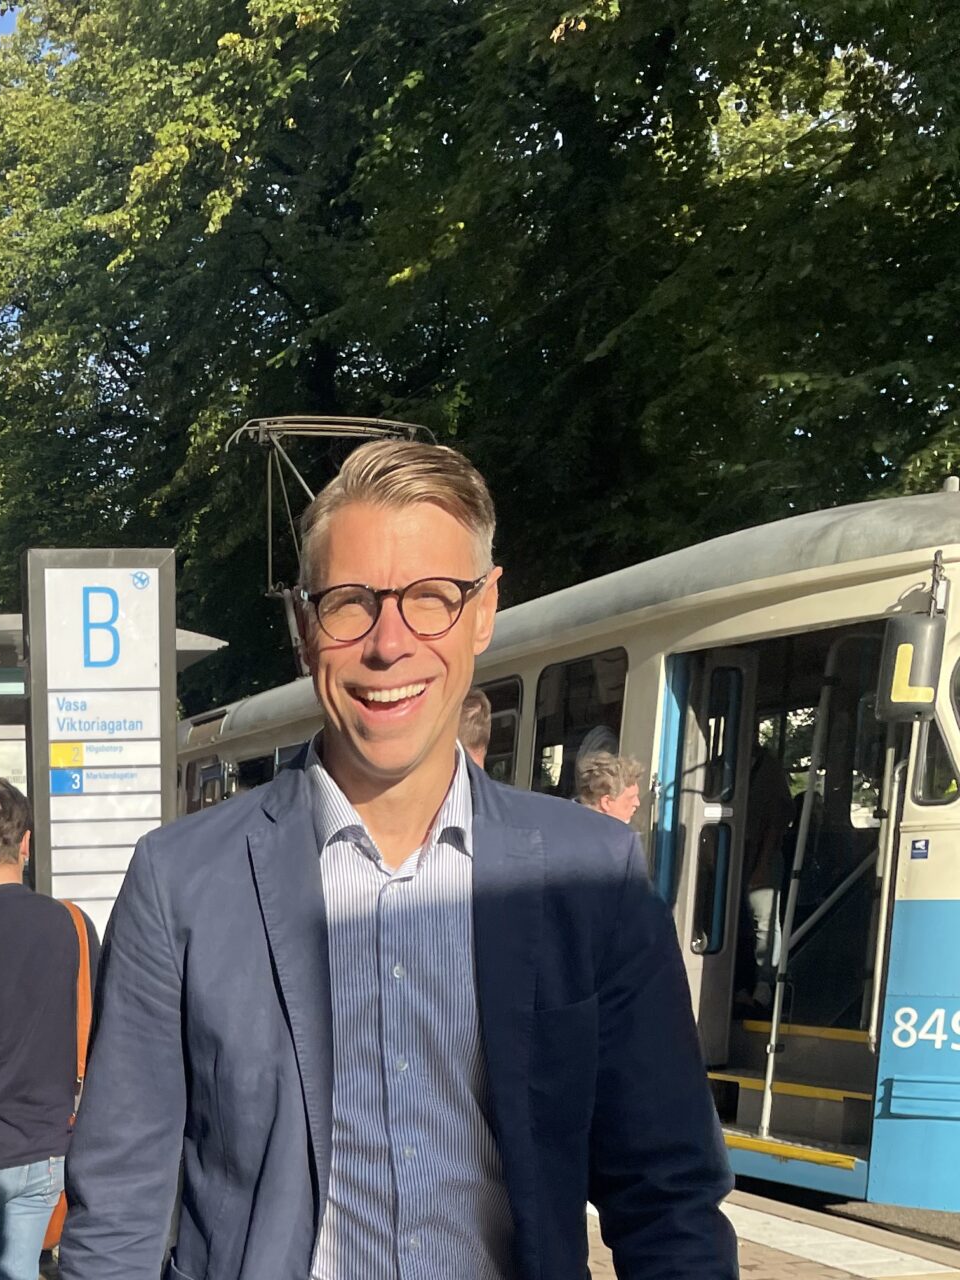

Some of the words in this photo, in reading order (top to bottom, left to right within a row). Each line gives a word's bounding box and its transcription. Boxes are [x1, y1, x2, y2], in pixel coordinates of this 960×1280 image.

[82, 586, 120, 668] B
[890, 643, 935, 703] L
[56, 696, 87, 711] Vasa
[56, 716, 144, 734] Viktoriagatan
[71, 746, 81, 763] 2
[71, 773, 81, 790] 3
